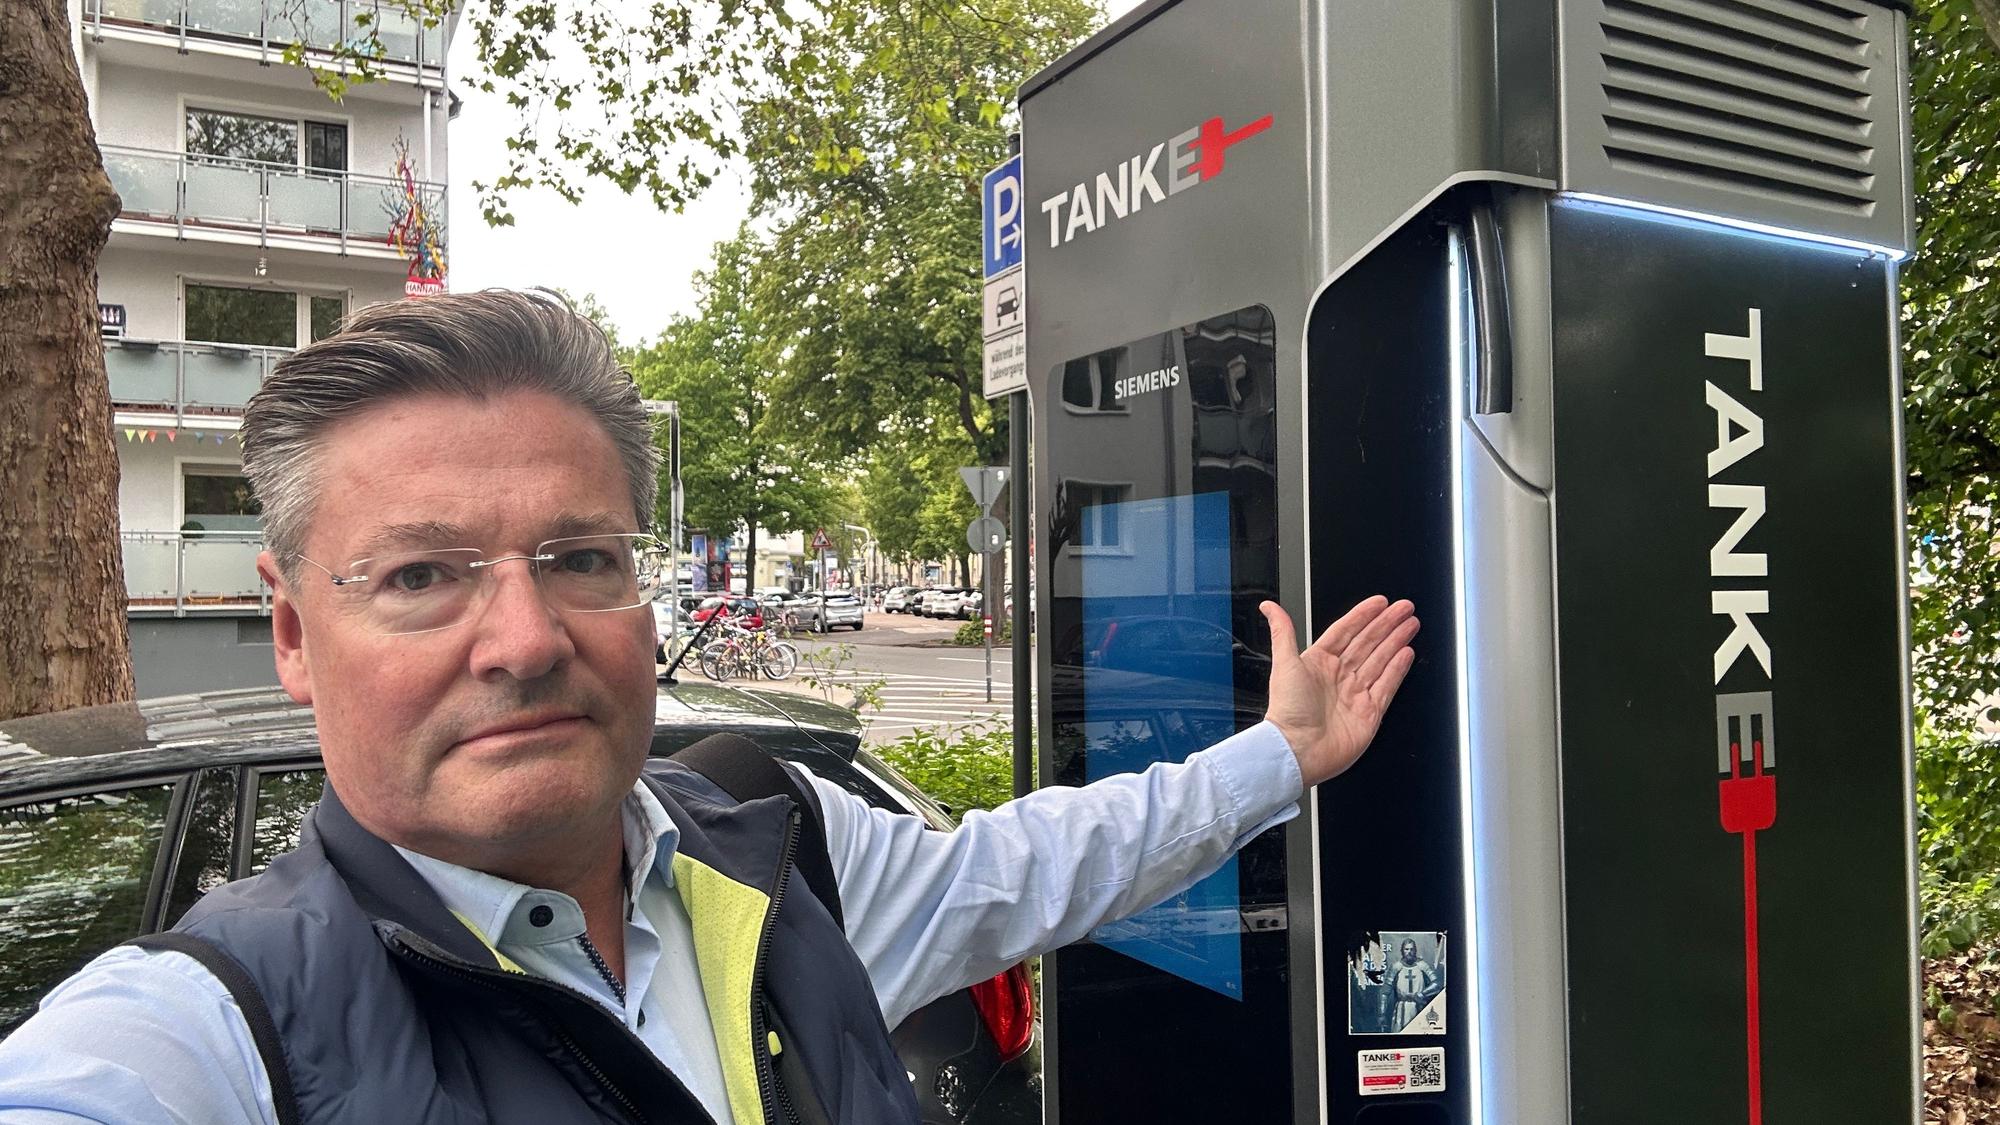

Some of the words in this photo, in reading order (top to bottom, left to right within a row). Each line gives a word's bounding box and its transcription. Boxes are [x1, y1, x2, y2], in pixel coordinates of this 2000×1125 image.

[993, 175, 1020, 262] P
[1041, 126, 1200, 249] TANKE
[1114, 365, 1180, 400] SIEMENS
[1704, 308, 1777, 774] TANKE
